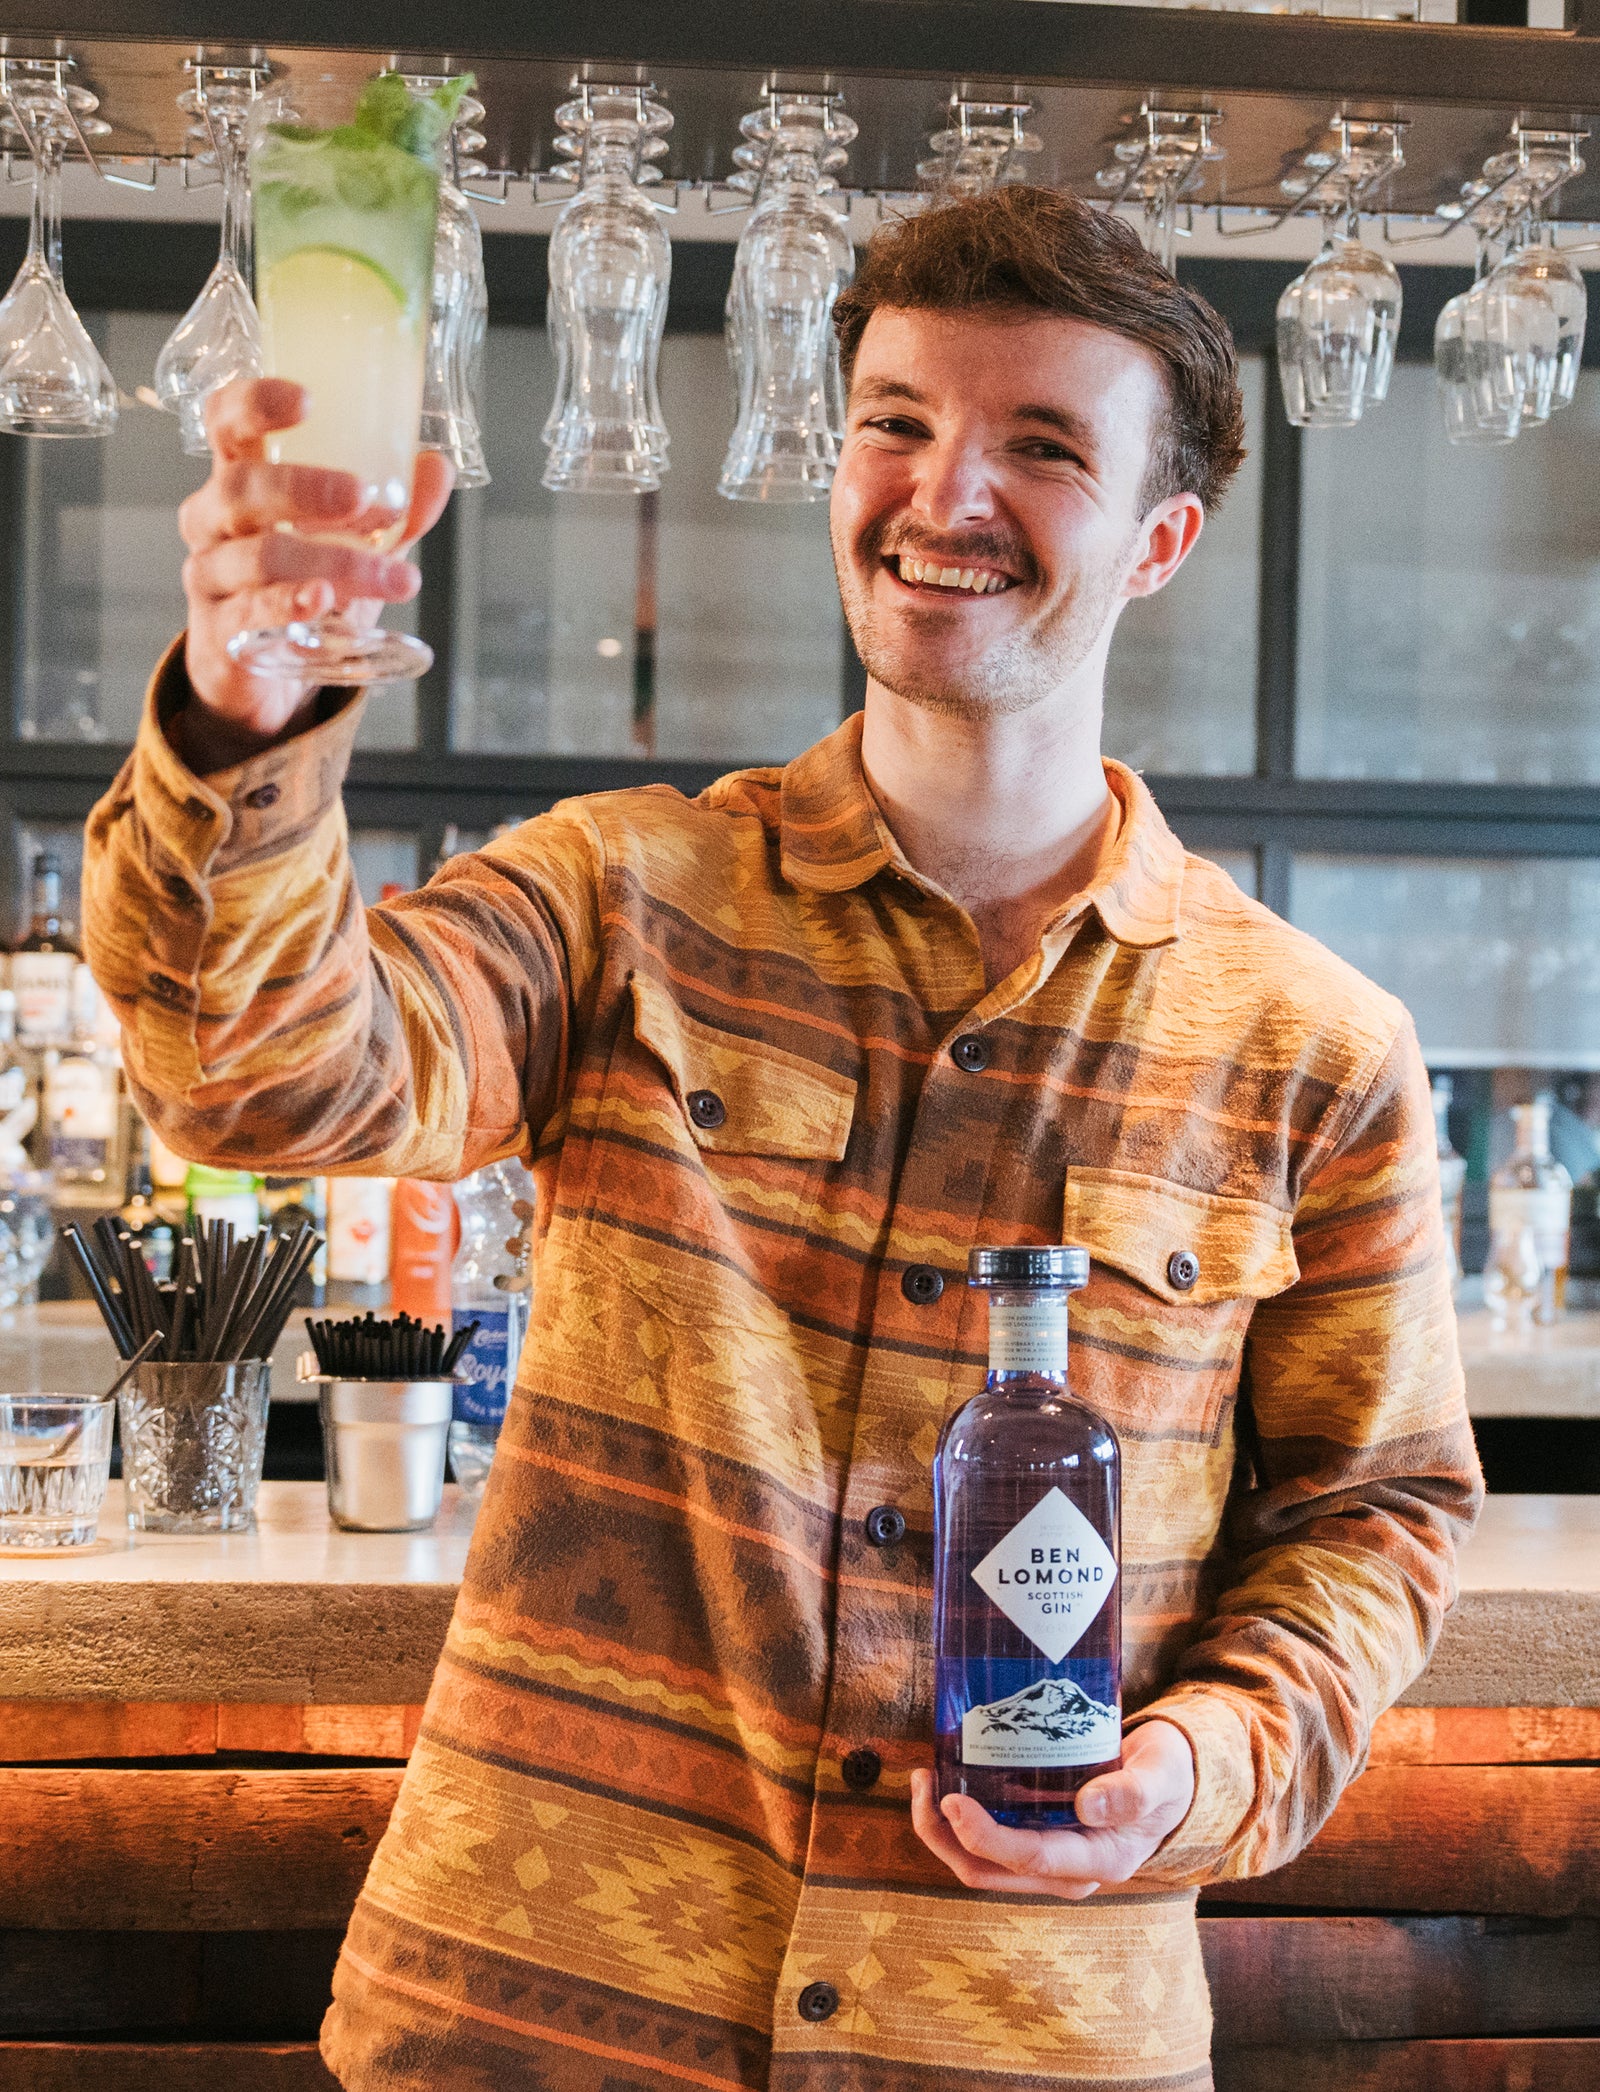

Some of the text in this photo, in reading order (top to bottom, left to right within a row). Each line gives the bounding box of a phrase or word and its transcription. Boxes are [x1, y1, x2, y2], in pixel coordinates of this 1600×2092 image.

[1031, 1548, 1081, 1564] BEN
[998, 1566, 1104, 1585] LOMOND
[1027, 1591, 1084, 1600] SCOTTISH
[1041, 1602, 1072, 1614] GIN
